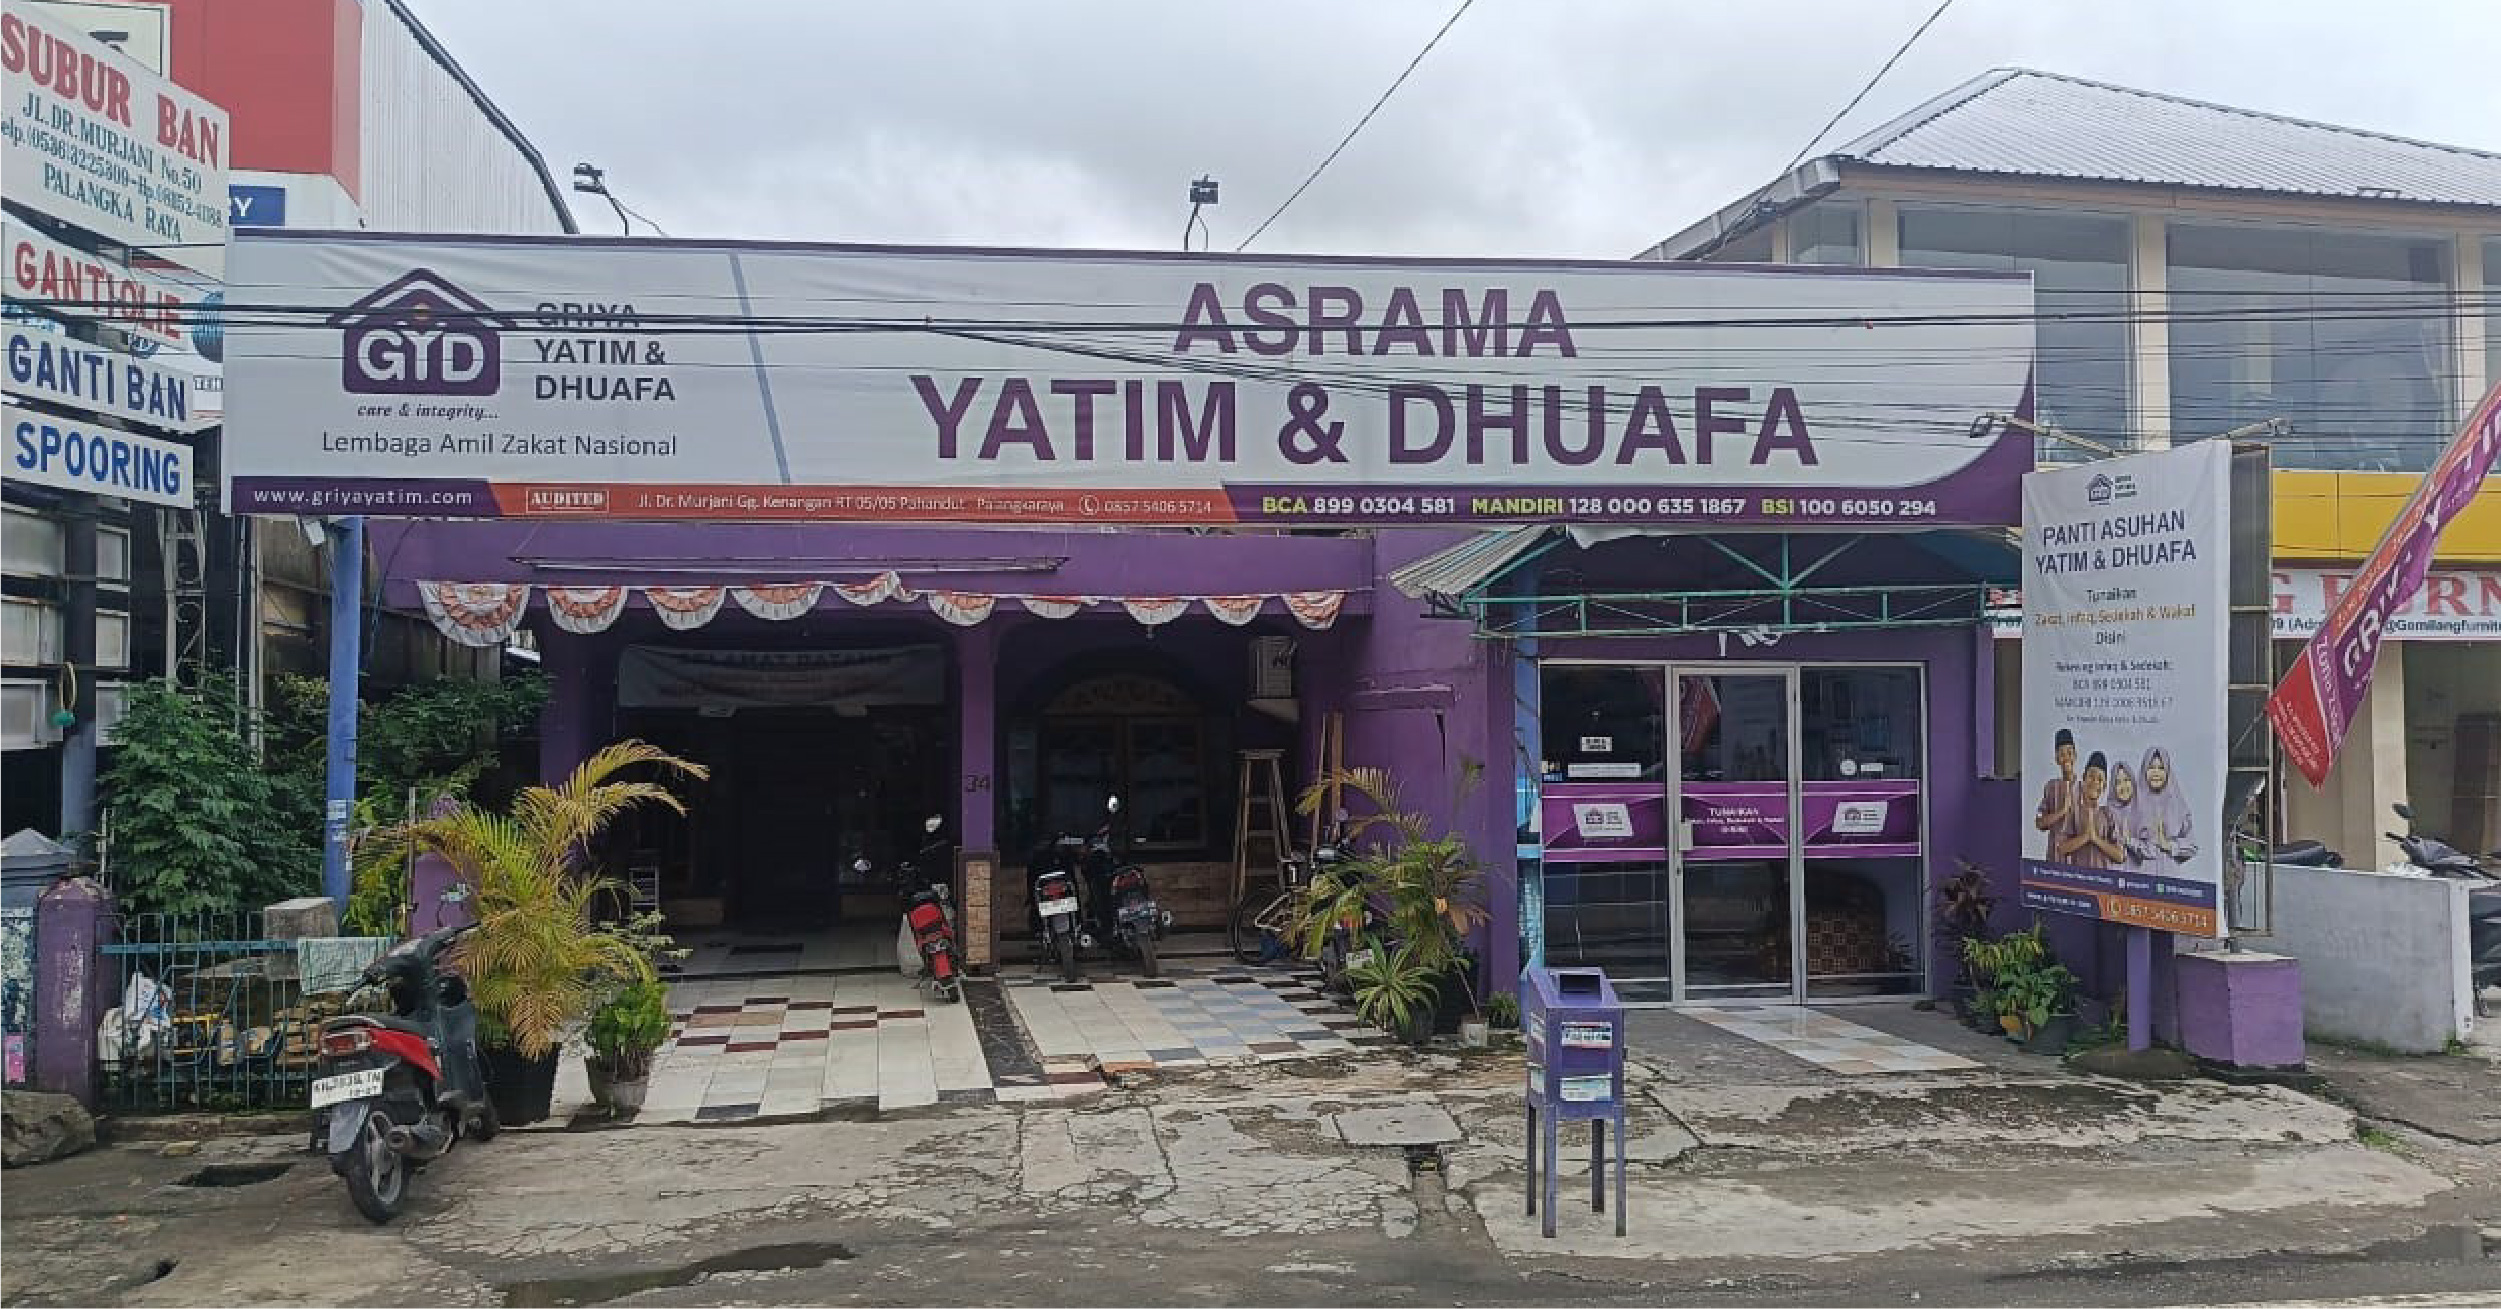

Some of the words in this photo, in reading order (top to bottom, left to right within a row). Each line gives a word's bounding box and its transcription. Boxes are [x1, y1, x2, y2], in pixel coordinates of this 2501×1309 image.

[1, 13, 131, 127] SUBUR
[158, 93, 218, 171] BAN
[44, 162, 134, 223] PALANGKA
[146, 206, 182, 243] RAYA
[15, 242, 115, 323] GANTI
[117, 279, 181, 339] OLIE
[534, 302, 641, 327] GRIYA
[1172, 283, 1578, 359] ASRAMA
[358, 329, 484, 381] GYD
[534, 338, 637, 365] YATIM
[645, 340, 667, 365] &
[8, 334, 115, 405] GANTI
[127, 364, 187, 422] BAN
[534, 374, 676, 401] DHUAFA
[357, 405, 391, 418] care
[397, 403, 410, 418] &
[416, 402, 499, 420] integrity...
[909, 374, 1236, 463] YATIM
[1277, 381, 1349, 466] &
[1387, 383, 1820, 468] DHUAFA
[15, 421, 181, 496] SPOORING
[322, 431, 430, 456] Lembaga
[440, 432, 494, 454] Amil
[501, 433, 567, 455] Zakat
[575, 435, 677, 457] Nasional
[254, 487, 472, 507] www.griyayatim.com
[531, 491, 605, 506] AUDITED
[656, 494, 674, 508] Dr.
[678, 494, 734, 511] Murjani
[763, 495, 832, 512] Kenangan
[1262, 496, 1308, 514] BCA
[1313, 497, 1355, 514] 899
[1359, 497, 1415, 514] 0304
[1419, 497, 1455, 514] 581
[1472, 497, 1563, 514] MANDIRI
[1568, 498, 1603, 514] 128
[1607, 498, 1652, 515] 000
[1657, 498, 1694, 514] 635
[1699, 498, 1747, 514] 1867
[1760, 499, 1795, 515] BSI
[1800, 499, 1836, 515] 100
[1841, 499, 1894, 516] 6050
[1898, 500, 1936, 516] 294
[2043, 522, 2096, 548] PANTI
[2100, 508, 2185, 540] ASUHAN
[2035, 551, 2089, 575] YATIM
[2093, 549, 2107, 570] &
[2112, 538, 2197, 569] DHUAFA
[967, 773, 991, 793] 34
